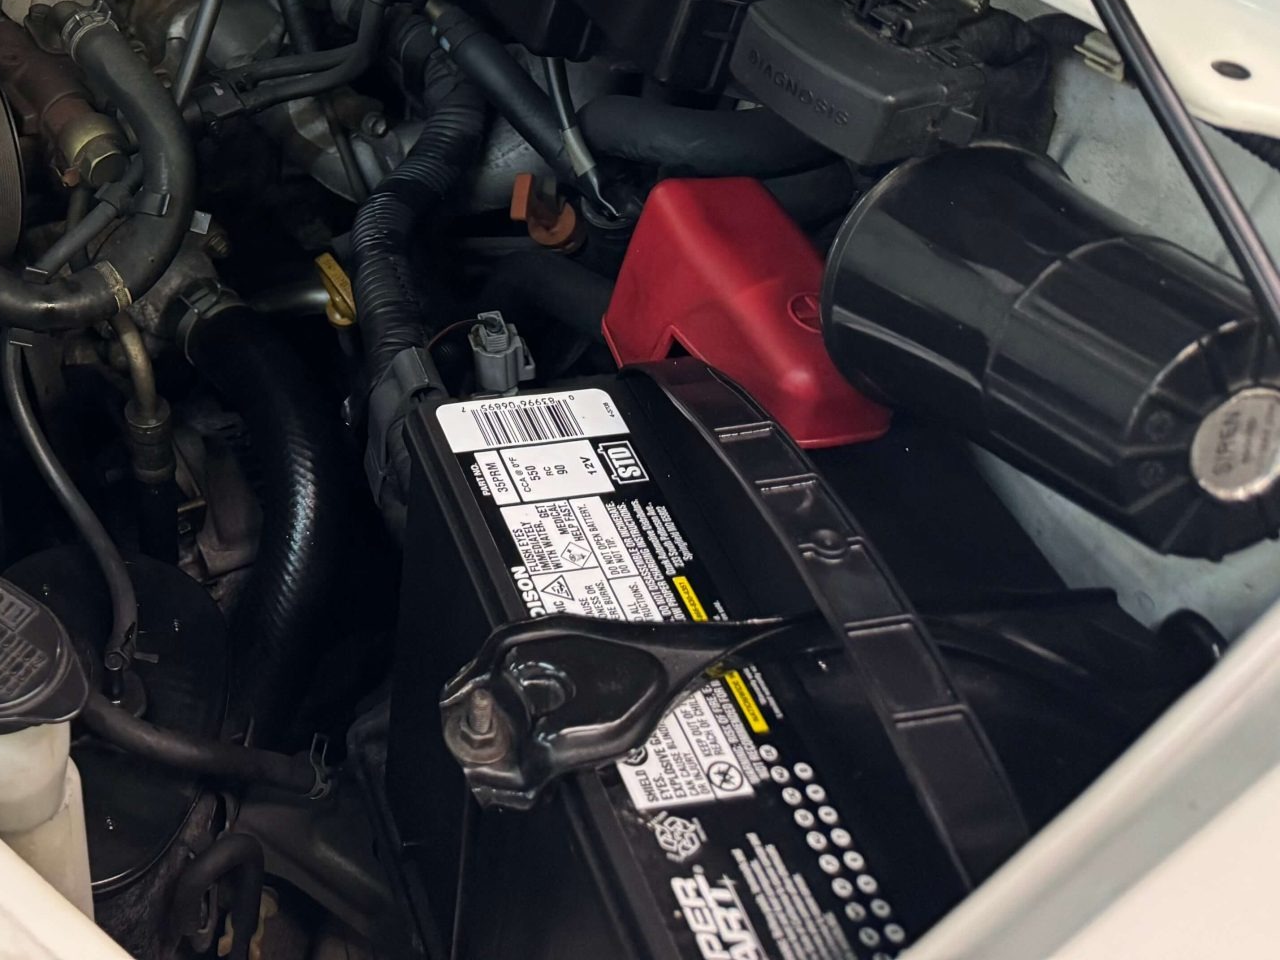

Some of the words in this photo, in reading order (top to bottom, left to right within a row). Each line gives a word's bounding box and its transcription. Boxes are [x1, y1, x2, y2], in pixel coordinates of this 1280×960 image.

[748, 48, 850, 128] DIAGNOSIS
[480, 402, 516, 411] 06895
[520, 396, 555, 407] 83996
[468, 463, 482, 475] NO.
[541, 465, 554, 476] RC
[553, 464, 569, 475] 90
[579, 455, 598, 475] 12V
[605, 445, 644, 478] STD
[484, 461, 509, 492] 35PRM
[523, 464, 541, 481] 550
[474, 476, 491, 495] PART
[517, 477, 532, 492] CCA
[534, 504, 550, 518] GET
[545, 503, 570, 535] MEDICAL
[555, 501, 575, 521] FAST.
[575, 503, 599, 532] BATTERY.
[566, 523, 585, 541] HELP
[614, 501, 647, 548] INSTRUCTIONS.
[648, 515, 670, 541] Patterson
[663, 521, 677, 531] MO
[510, 528, 530, 547] EYES
[531, 520, 554, 548] WATER.
[591, 532, 607, 549] OPEN
[604, 537, 618, 548] TIP.
[621, 537, 636, 547] OR
[518, 520, 553, 571] IMMEDIATELY
[644, 529, 668, 559] Automotive
[661, 540, 679, 556] South
[668, 530, 695, 561] Springfield
[520, 548, 541, 572] FLUSH
[545, 549, 564, 569] WITH
[600, 551, 615, 564] NOT
[610, 550, 625, 563] NOT
[638, 547, 664, 581] CHARGING
[670, 556, 685, 567] 233
[607, 565, 620, 575] DO
[618, 564, 630, 573] DO
[627, 546, 658, 590] DISASSEMBLE
[658, 559, 677, 575] Ozark
[583, 584, 596, 594] OR
[593, 579, 614, 605] BURNS.
[649, 590, 665, 604] NOT
[655, 580, 679, 606] PROPER
[577, 596, 595, 614] AUSE
[588, 595, 609, 618] DNESS
[625, 602, 640, 614] ALL
[657, 605, 672, 616] DO
[712, 687, 730, 702] FOR
[679, 708, 694, 719] OF
[714, 713, 729, 724] OF
[685, 720, 703, 736] OUT
[695, 718, 710, 728] OF
[720, 703, 762, 761] RECOMMENDED
[654, 721, 678, 749] BLIND
[702, 729, 725, 755] REACH
[719, 724, 740, 743] RISK
[694, 737, 713, 756] KEEP
[651, 747, 688, 797] EXPLOSIVE
[669, 751, 691, 777] CAUSE
[751, 761, 771, 779] NOT
[632, 769, 660, 802] SHIELD
[649, 772, 674, 800] EYES.
[683, 779, 700, 796] CAN
[697, 783, 711, 794] OR
[670, 877, 732, 960] PER
[693, 873, 761, 960] ART
